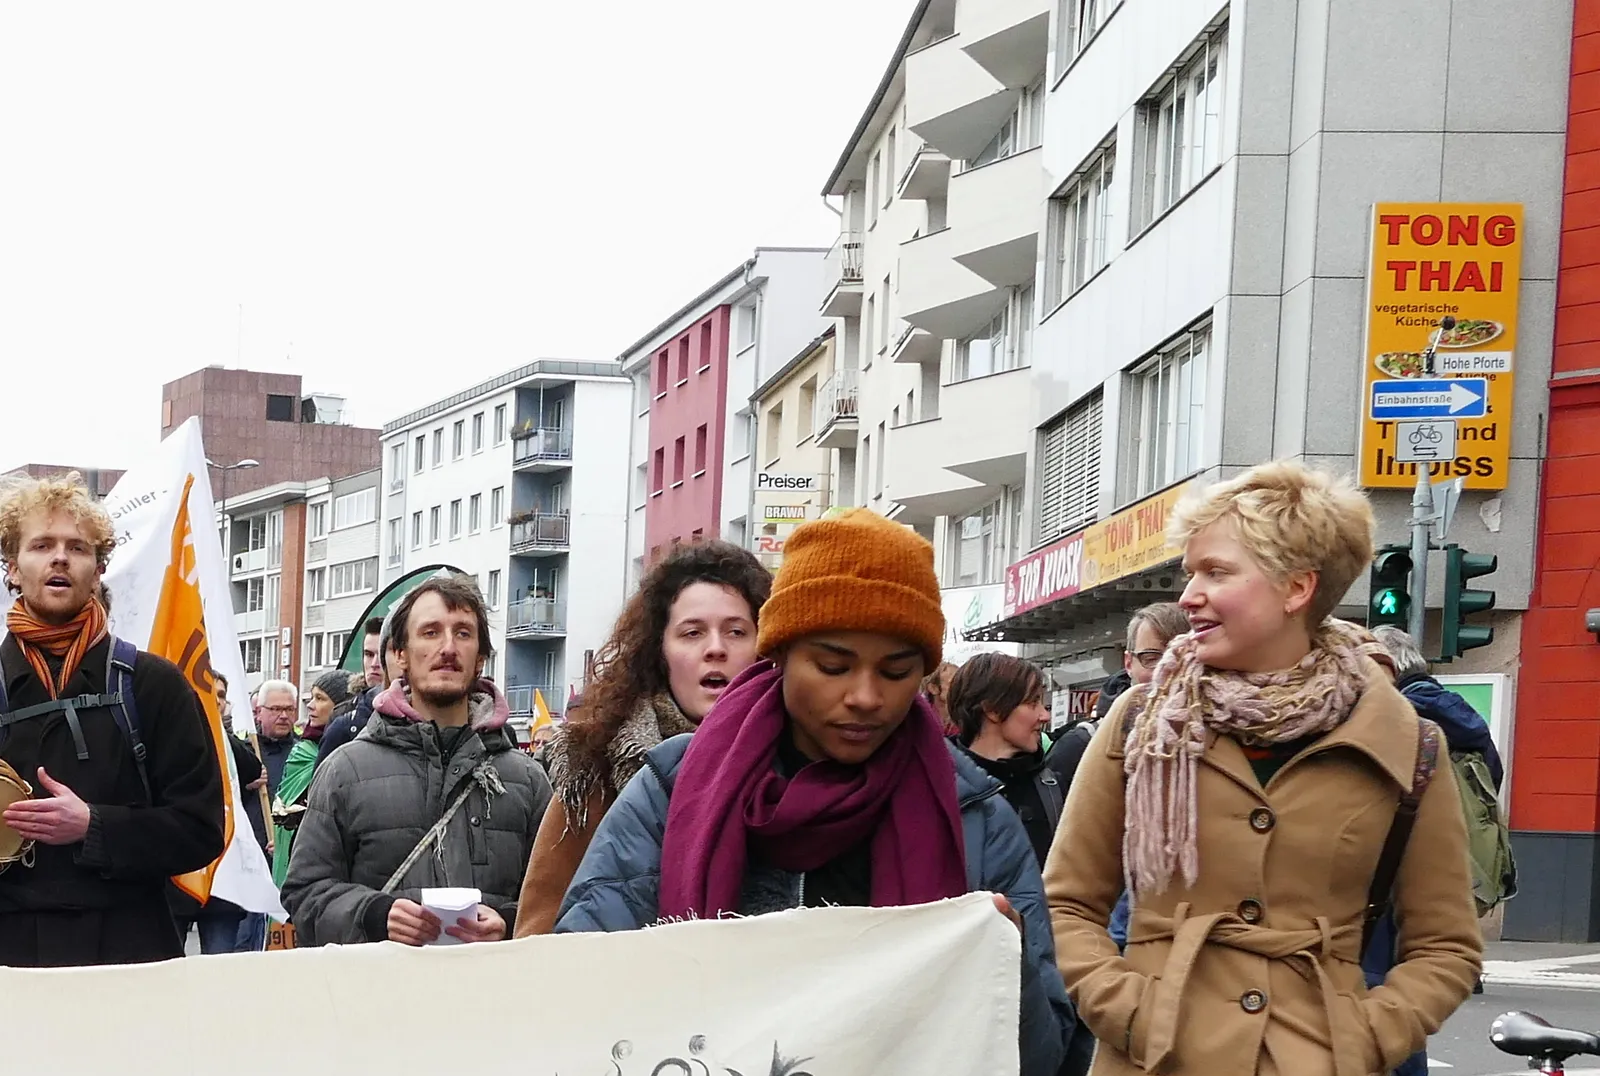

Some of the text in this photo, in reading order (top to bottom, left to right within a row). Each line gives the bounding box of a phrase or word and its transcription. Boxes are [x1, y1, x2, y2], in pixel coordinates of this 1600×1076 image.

[1379, 214, 1515, 246] TONG
[1386, 260, 1503, 292] THAI
[1375, 303, 1459, 315] vegetarische
[1395, 316, 1438, 326] Küche
[1443, 356, 1505, 369] Hohe Pforte
[1377, 394, 1453, 405] Einbahnstraße
[758, 473, 813, 489] Preiser
[111, 491, 157, 519] stiller
[765, 506, 805, 519] BRAWA
[1105, 513, 1133, 555] TONG
[1137, 498, 1165, 541] THAI
[1041, 538, 1083, 599] KIOSK
